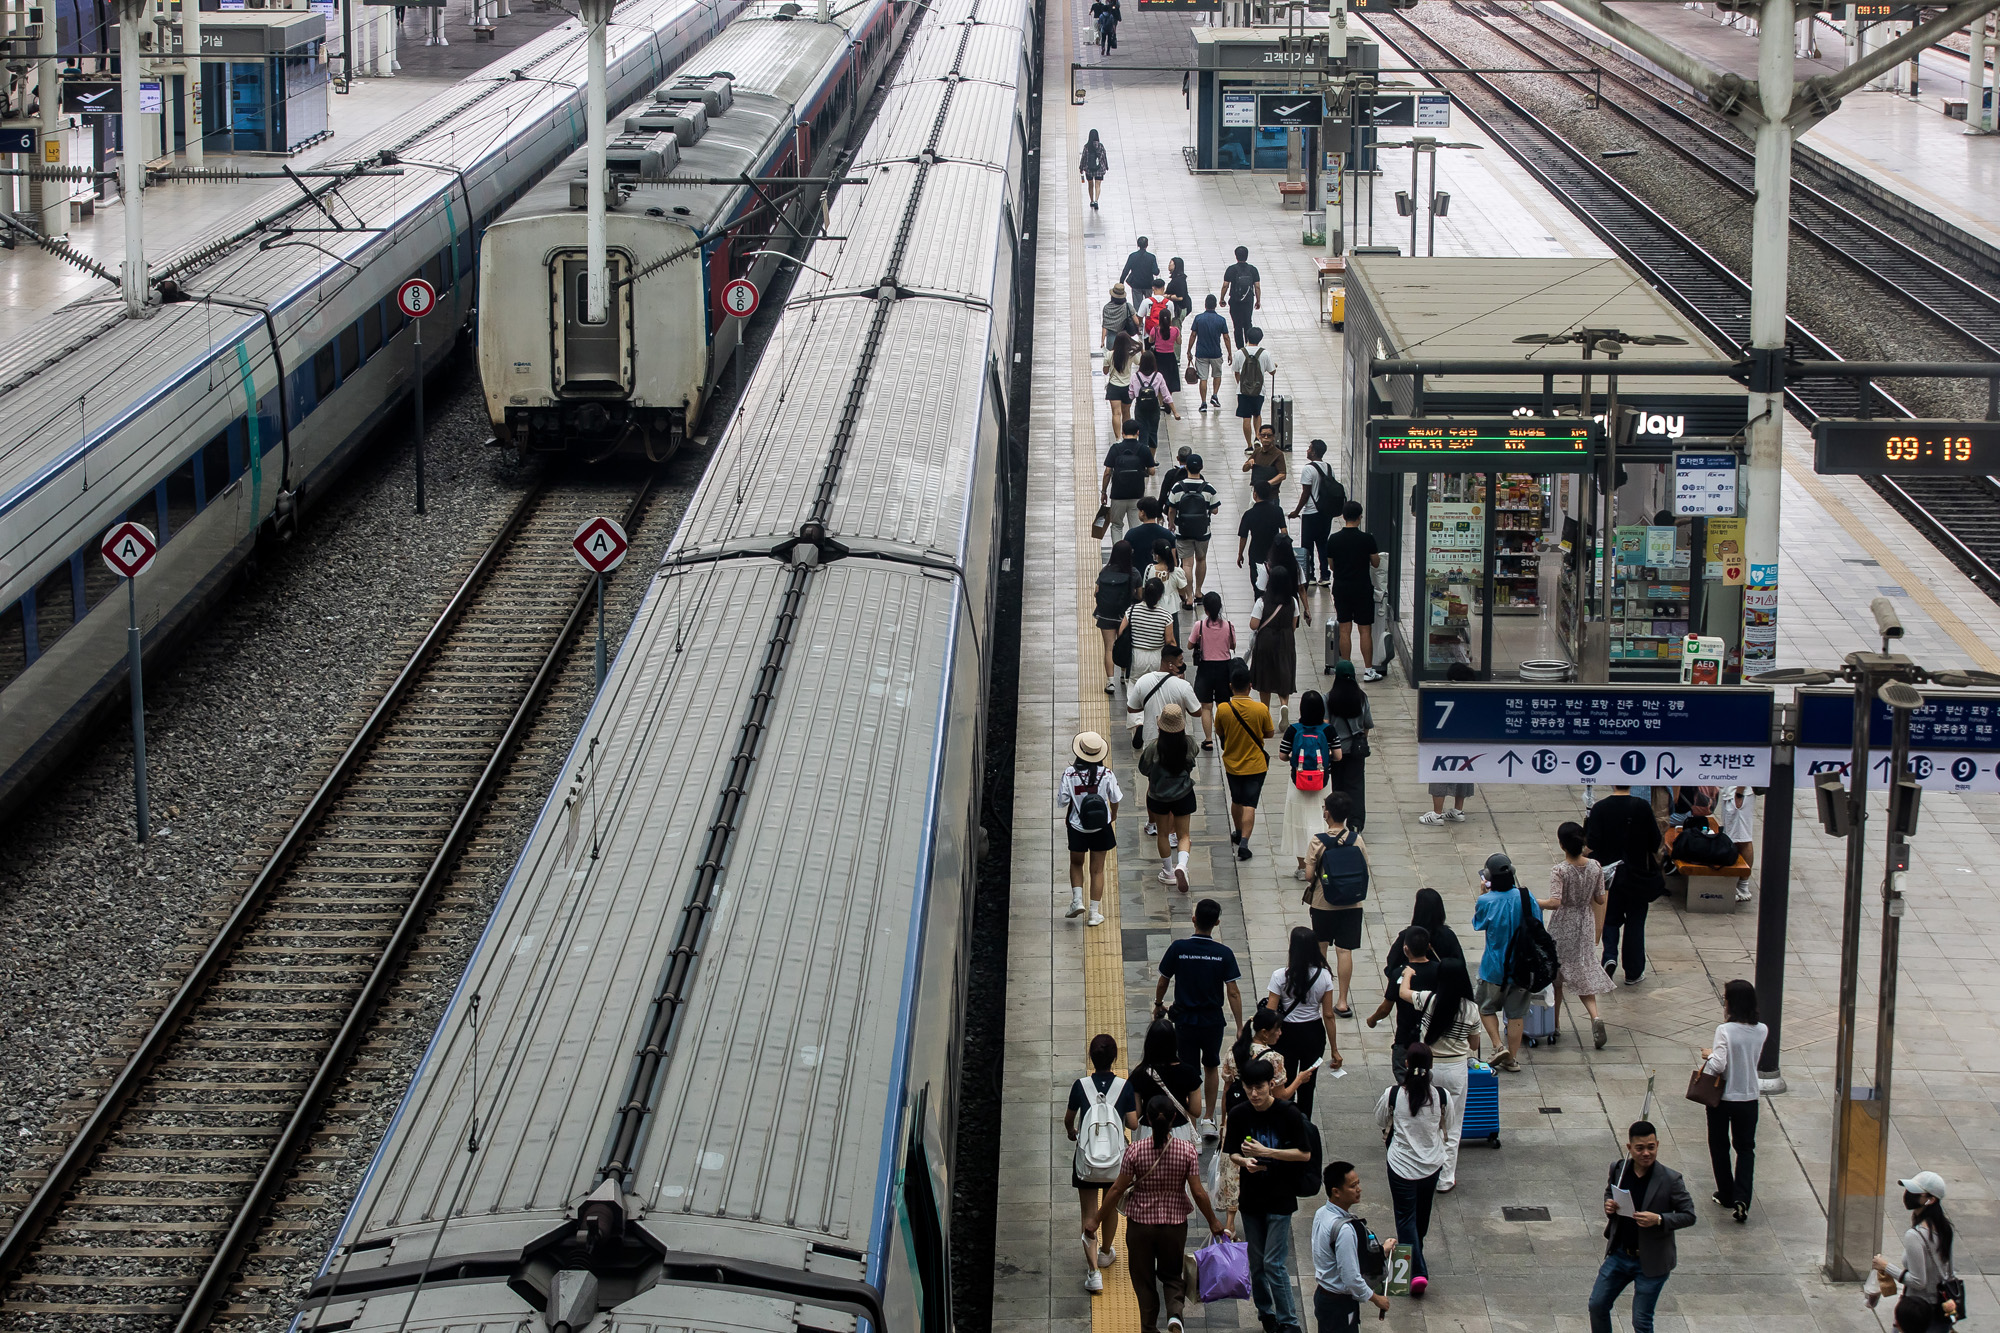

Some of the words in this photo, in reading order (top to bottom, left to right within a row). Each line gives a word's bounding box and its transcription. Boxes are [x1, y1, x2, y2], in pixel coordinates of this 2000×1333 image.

[1857, 5, 1891, 15] 09:19
[20, 134, 31, 148] 6
[412, 286, 420, 298] 8
[736, 286, 744, 298] 8
[412, 299, 421, 311] 6
[736, 299, 744, 311] 6
[1886, 437, 1971, 461] 09:19
[122, 539, 137, 557] A
[593, 533, 608, 552] A
[1696, 660, 1715, 668] AED
[1506, 699, 1523, 709] 대전
[1531, 699, 1557, 709] 동대구
[1565, 699, 1583, 709] 부산
[1591, 699, 1609, 710] 포항
[1617, 700, 1634, 710] 진주
[1642, 700, 1660, 710] 마산
[1434, 701, 1455, 729] 7
[1945, 706, 1963, 716] 부산
[1971, 706, 1989, 716] 포항
[1505, 717, 1523, 727] 익산
[1531, 717, 1565, 728] 광주송정
[1573, 718, 1590, 728] 목포
[1599, 718, 1640, 728] 여수EXPO
[1644, 719, 1661, 729] 방면
[1909, 723, 1926, 733] 익산
[1933, 723, 1967, 734] 광주송정
[1975, 724, 1992, 734] 목포
[1432, 753, 1488, 771] KTX
[1533, 753, 1557, 770] 18
[1583, 755, 1595, 771] 9
[1629, 754, 1637, 771] 1
[1699, 753, 1756, 769] 호차번호
[1958, 762, 1970, 778] 9
